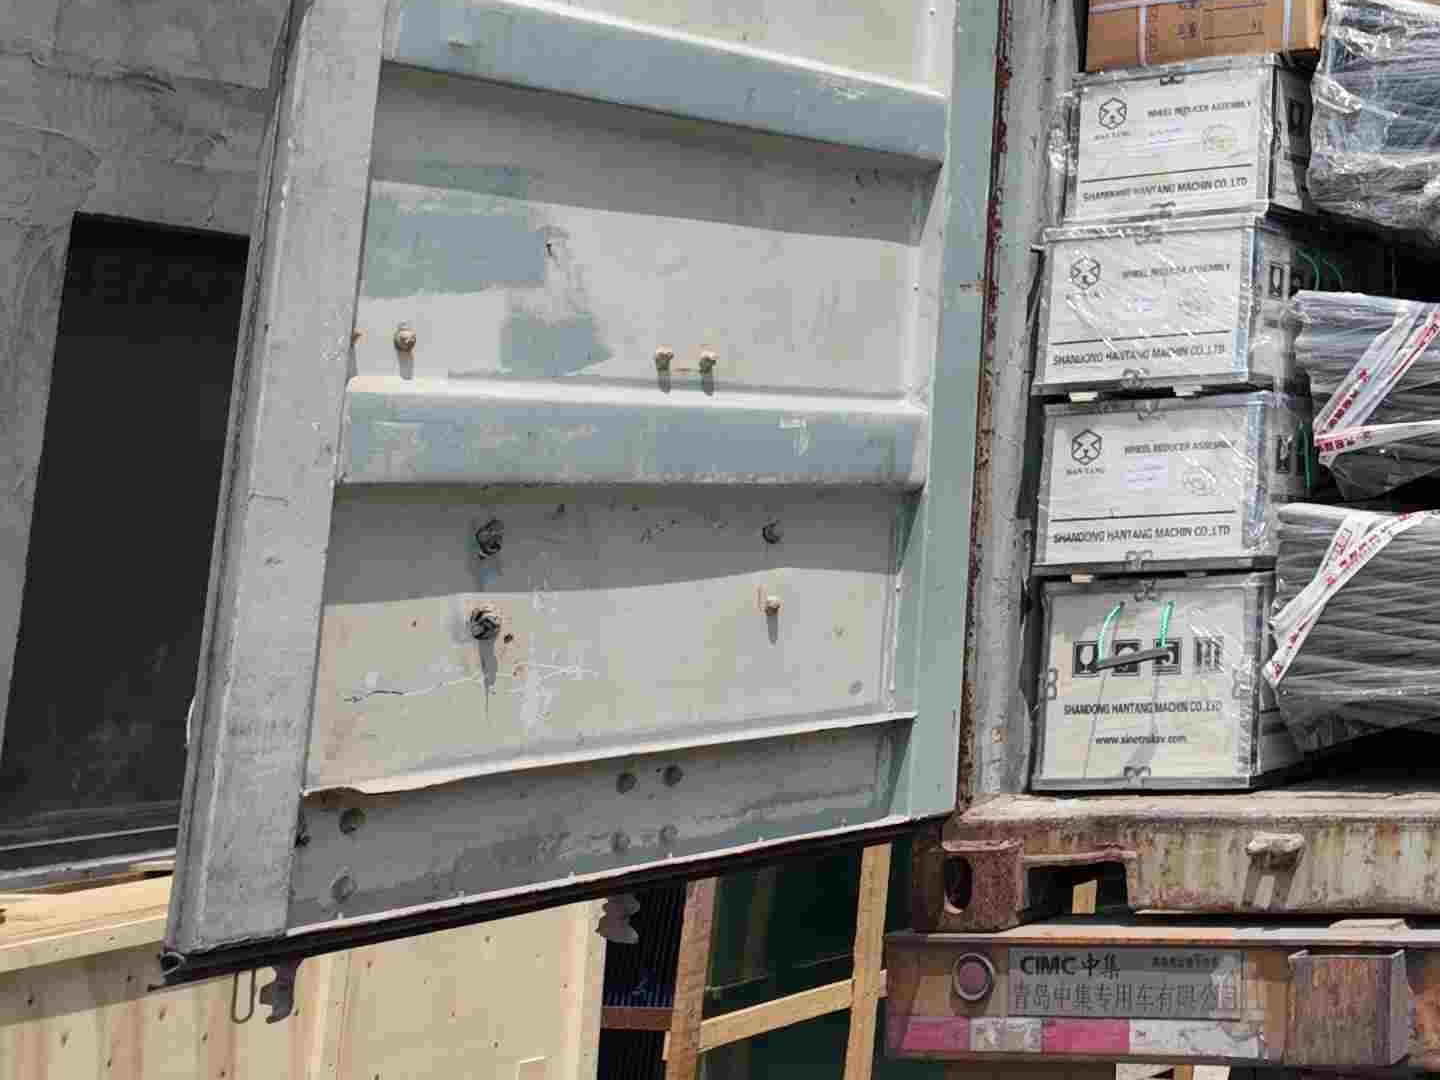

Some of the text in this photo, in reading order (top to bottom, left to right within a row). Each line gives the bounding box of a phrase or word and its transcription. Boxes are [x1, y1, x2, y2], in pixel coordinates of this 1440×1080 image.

[1053, 530, 1105, 544] SHANDONG
[1107, 527, 1153, 540] HANTANG
[1155, 526, 1193, 539] MACHIN
[1063, 703, 1110, 716] SHANDONG
[1111, 702, 1153, 714] HANTANG
